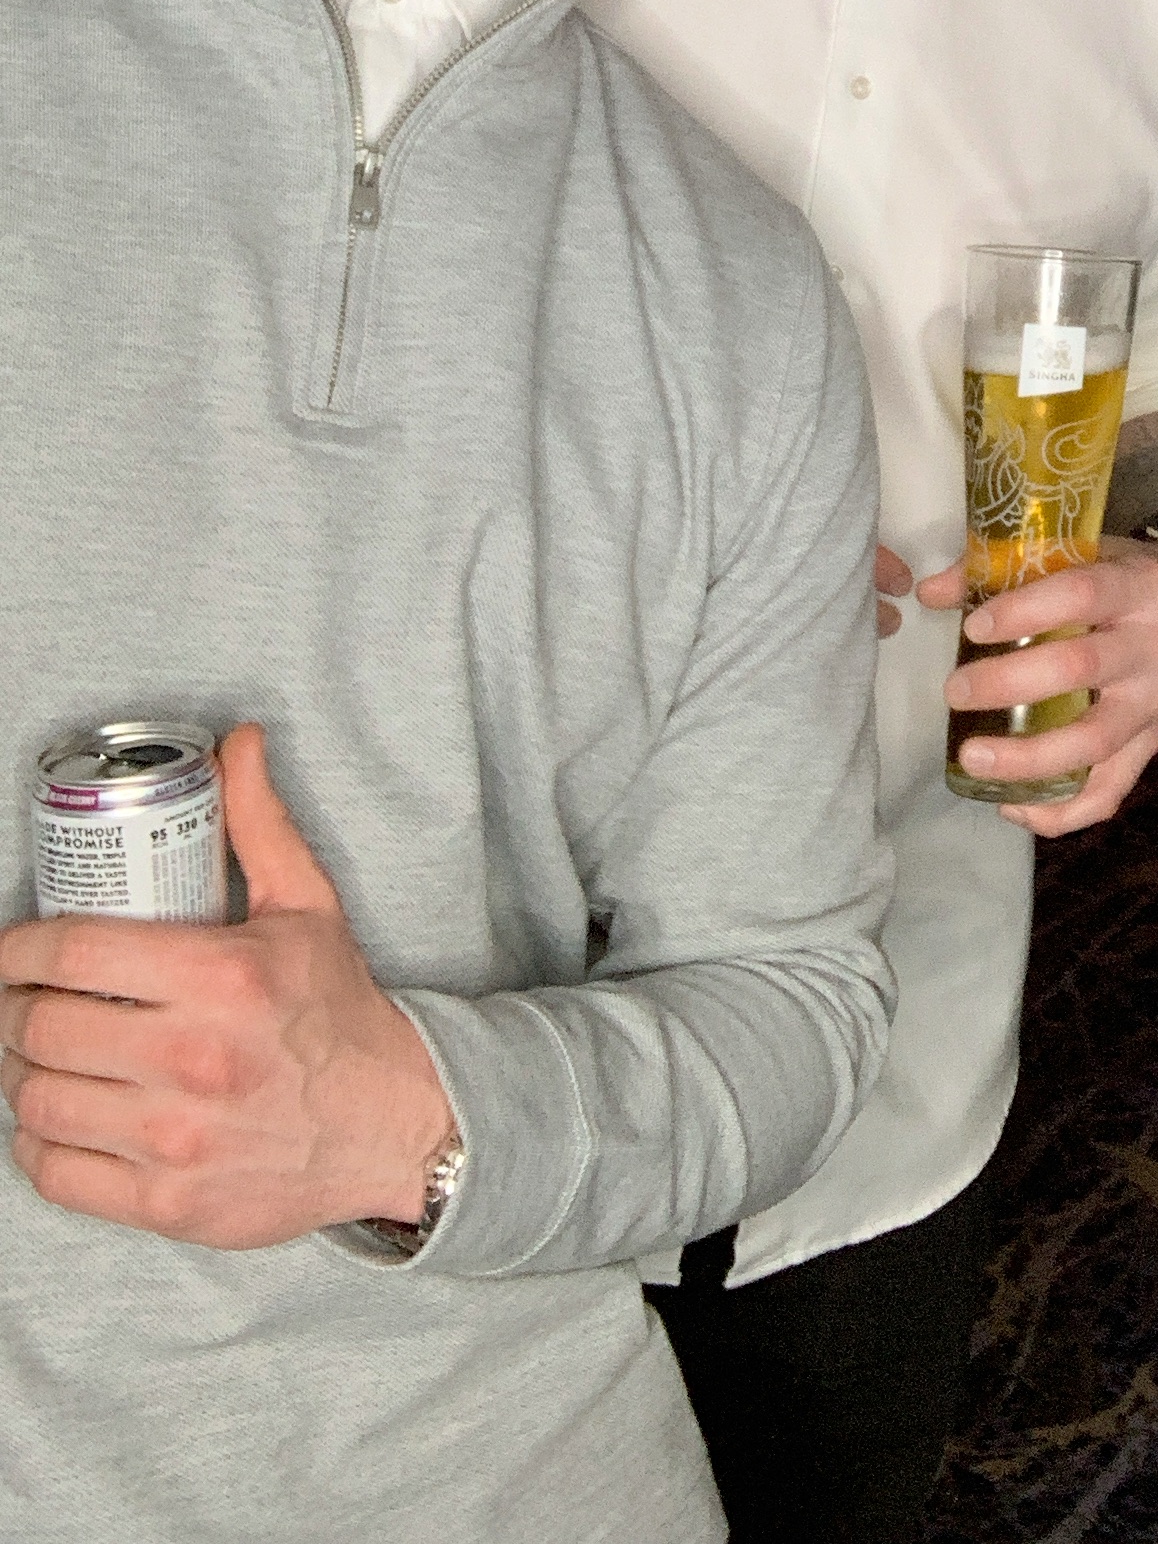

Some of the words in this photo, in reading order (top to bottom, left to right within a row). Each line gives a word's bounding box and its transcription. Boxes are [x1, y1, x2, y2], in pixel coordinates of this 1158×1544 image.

[1028, 370, 1076, 382] SINGHA
[60, 825, 124, 838] WITHOUT
[150, 828, 168, 842] 95
[176, 817, 198, 836] 330
[38, 831, 125, 849] OMPROMISE
